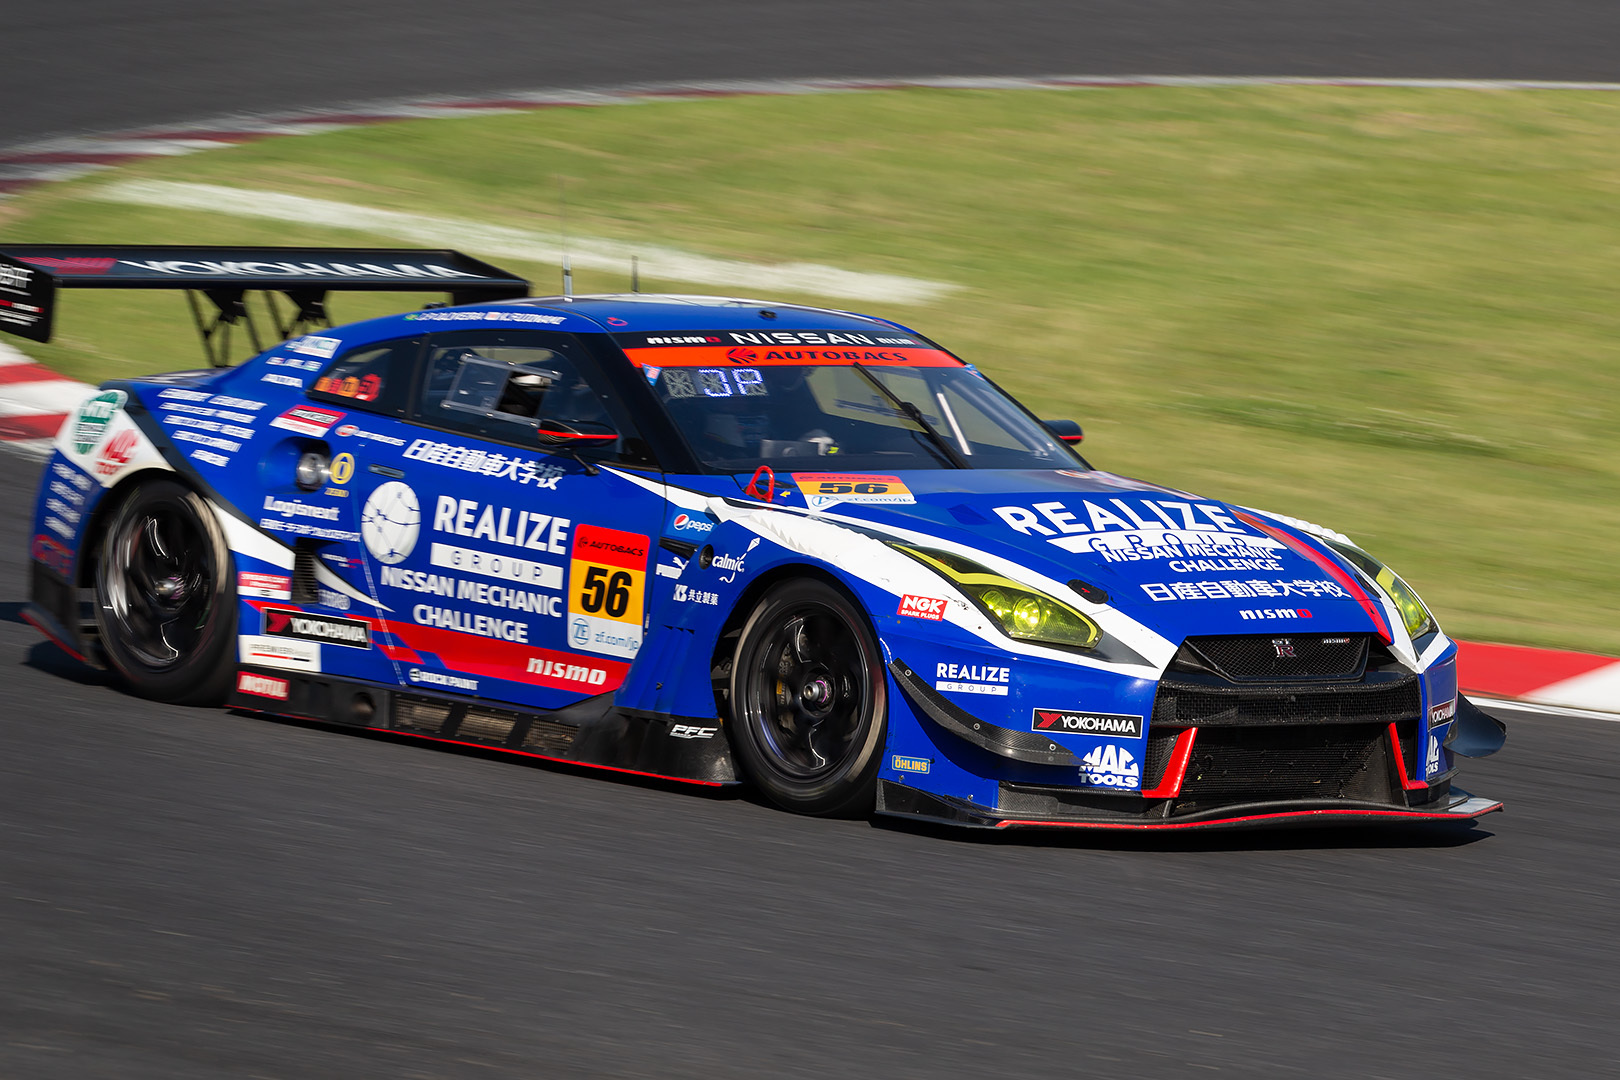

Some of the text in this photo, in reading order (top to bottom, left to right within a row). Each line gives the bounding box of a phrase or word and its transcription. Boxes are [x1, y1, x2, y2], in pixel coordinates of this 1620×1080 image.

[116, 260, 491, 279] YOKOHAMA
[646, 336, 722, 345] nismo
[728, 332, 876, 346] NISSAN
[764, 350, 908, 361] AUTOBACS
[698, 368, 764, 397] JP
[402, 438, 567, 490] 日産自動車大学校
[818, 482, 889, 494] 56
[433, 495, 571, 555] REALIZE
[685, 519, 715, 532] pepsi
[992, 498, 1248, 536] REALIZE
[589, 541, 644, 557] AUTOBACS
[1101, 543, 1283, 563] NISSAN MECHANIC
[450, 550, 544, 580] GROUP
[711, 552, 745, 573] calmic
[1169, 558, 1285, 573] CHALLENGE
[380, 565, 563, 618] NISSAN MECHANIC
[581, 565, 633, 618] 56
[687, 589, 719, 606] 共立製薬
[1139, 579, 1352, 602] 日産自動車大学校
[902, 595, 944, 614] NGK
[1239, 608, 1313, 620] nismo
[413, 603, 529, 644] CHALLENGE
[900, 609, 940, 620] SPARK PLUGS
[290, 617, 368, 643] YOKOHAMA
[595, 631, 639, 651] zf.com/jp
[526, 658, 607, 686] nismo
[936, 663, 1010, 683] REALIZE
[946, 683, 998, 694] GROUP
[671, 724, 718, 737] PFC
[1061, 715, 1136, 734] YOKOHAMA
[894, 756, 927, 772] ÖHLINS
[1081, 745, 1139, 776] MAC
[1078, 772, 1139, 789] TOOLS
